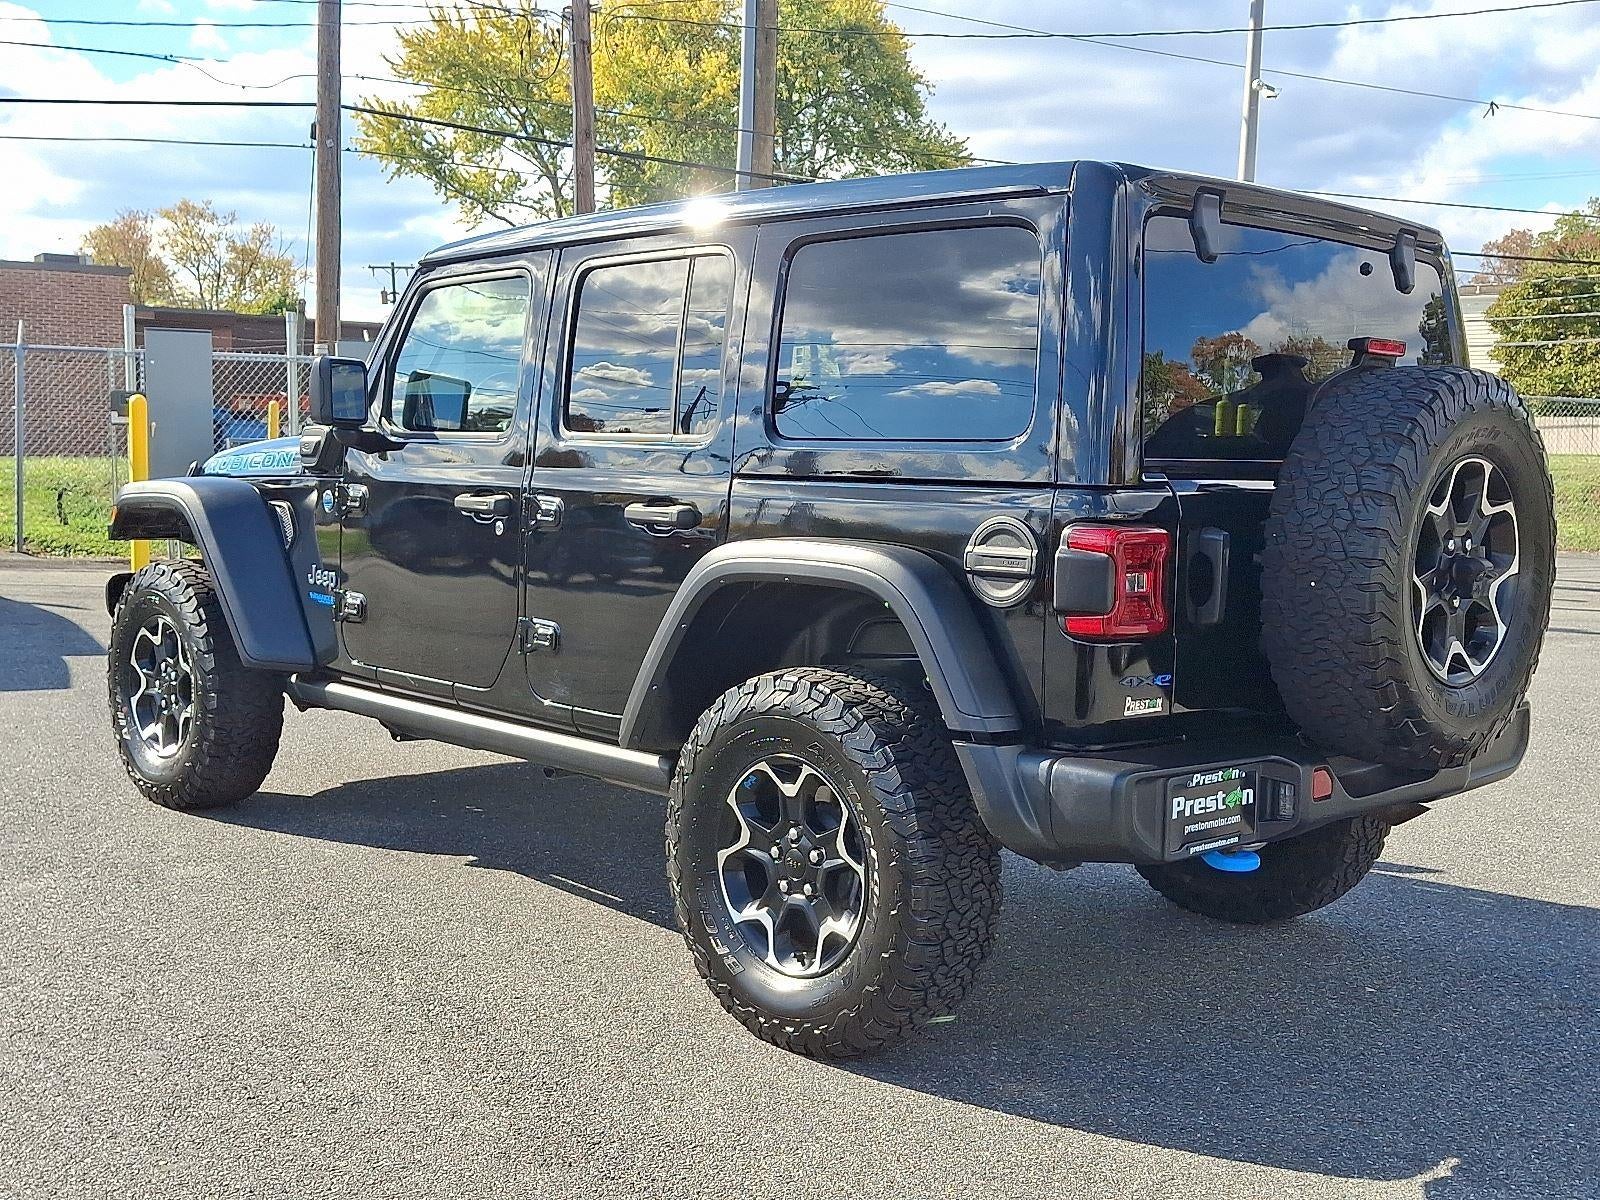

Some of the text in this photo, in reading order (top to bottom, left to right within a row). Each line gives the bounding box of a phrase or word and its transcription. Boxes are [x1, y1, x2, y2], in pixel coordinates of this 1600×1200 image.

[307, 564, 336, 591] Jeep
[1192, 768, 1240, 787] Preston
[1172, 786, 1254, 820] Preston
[1184, 814, 1241, 836] prestonmotor.com
